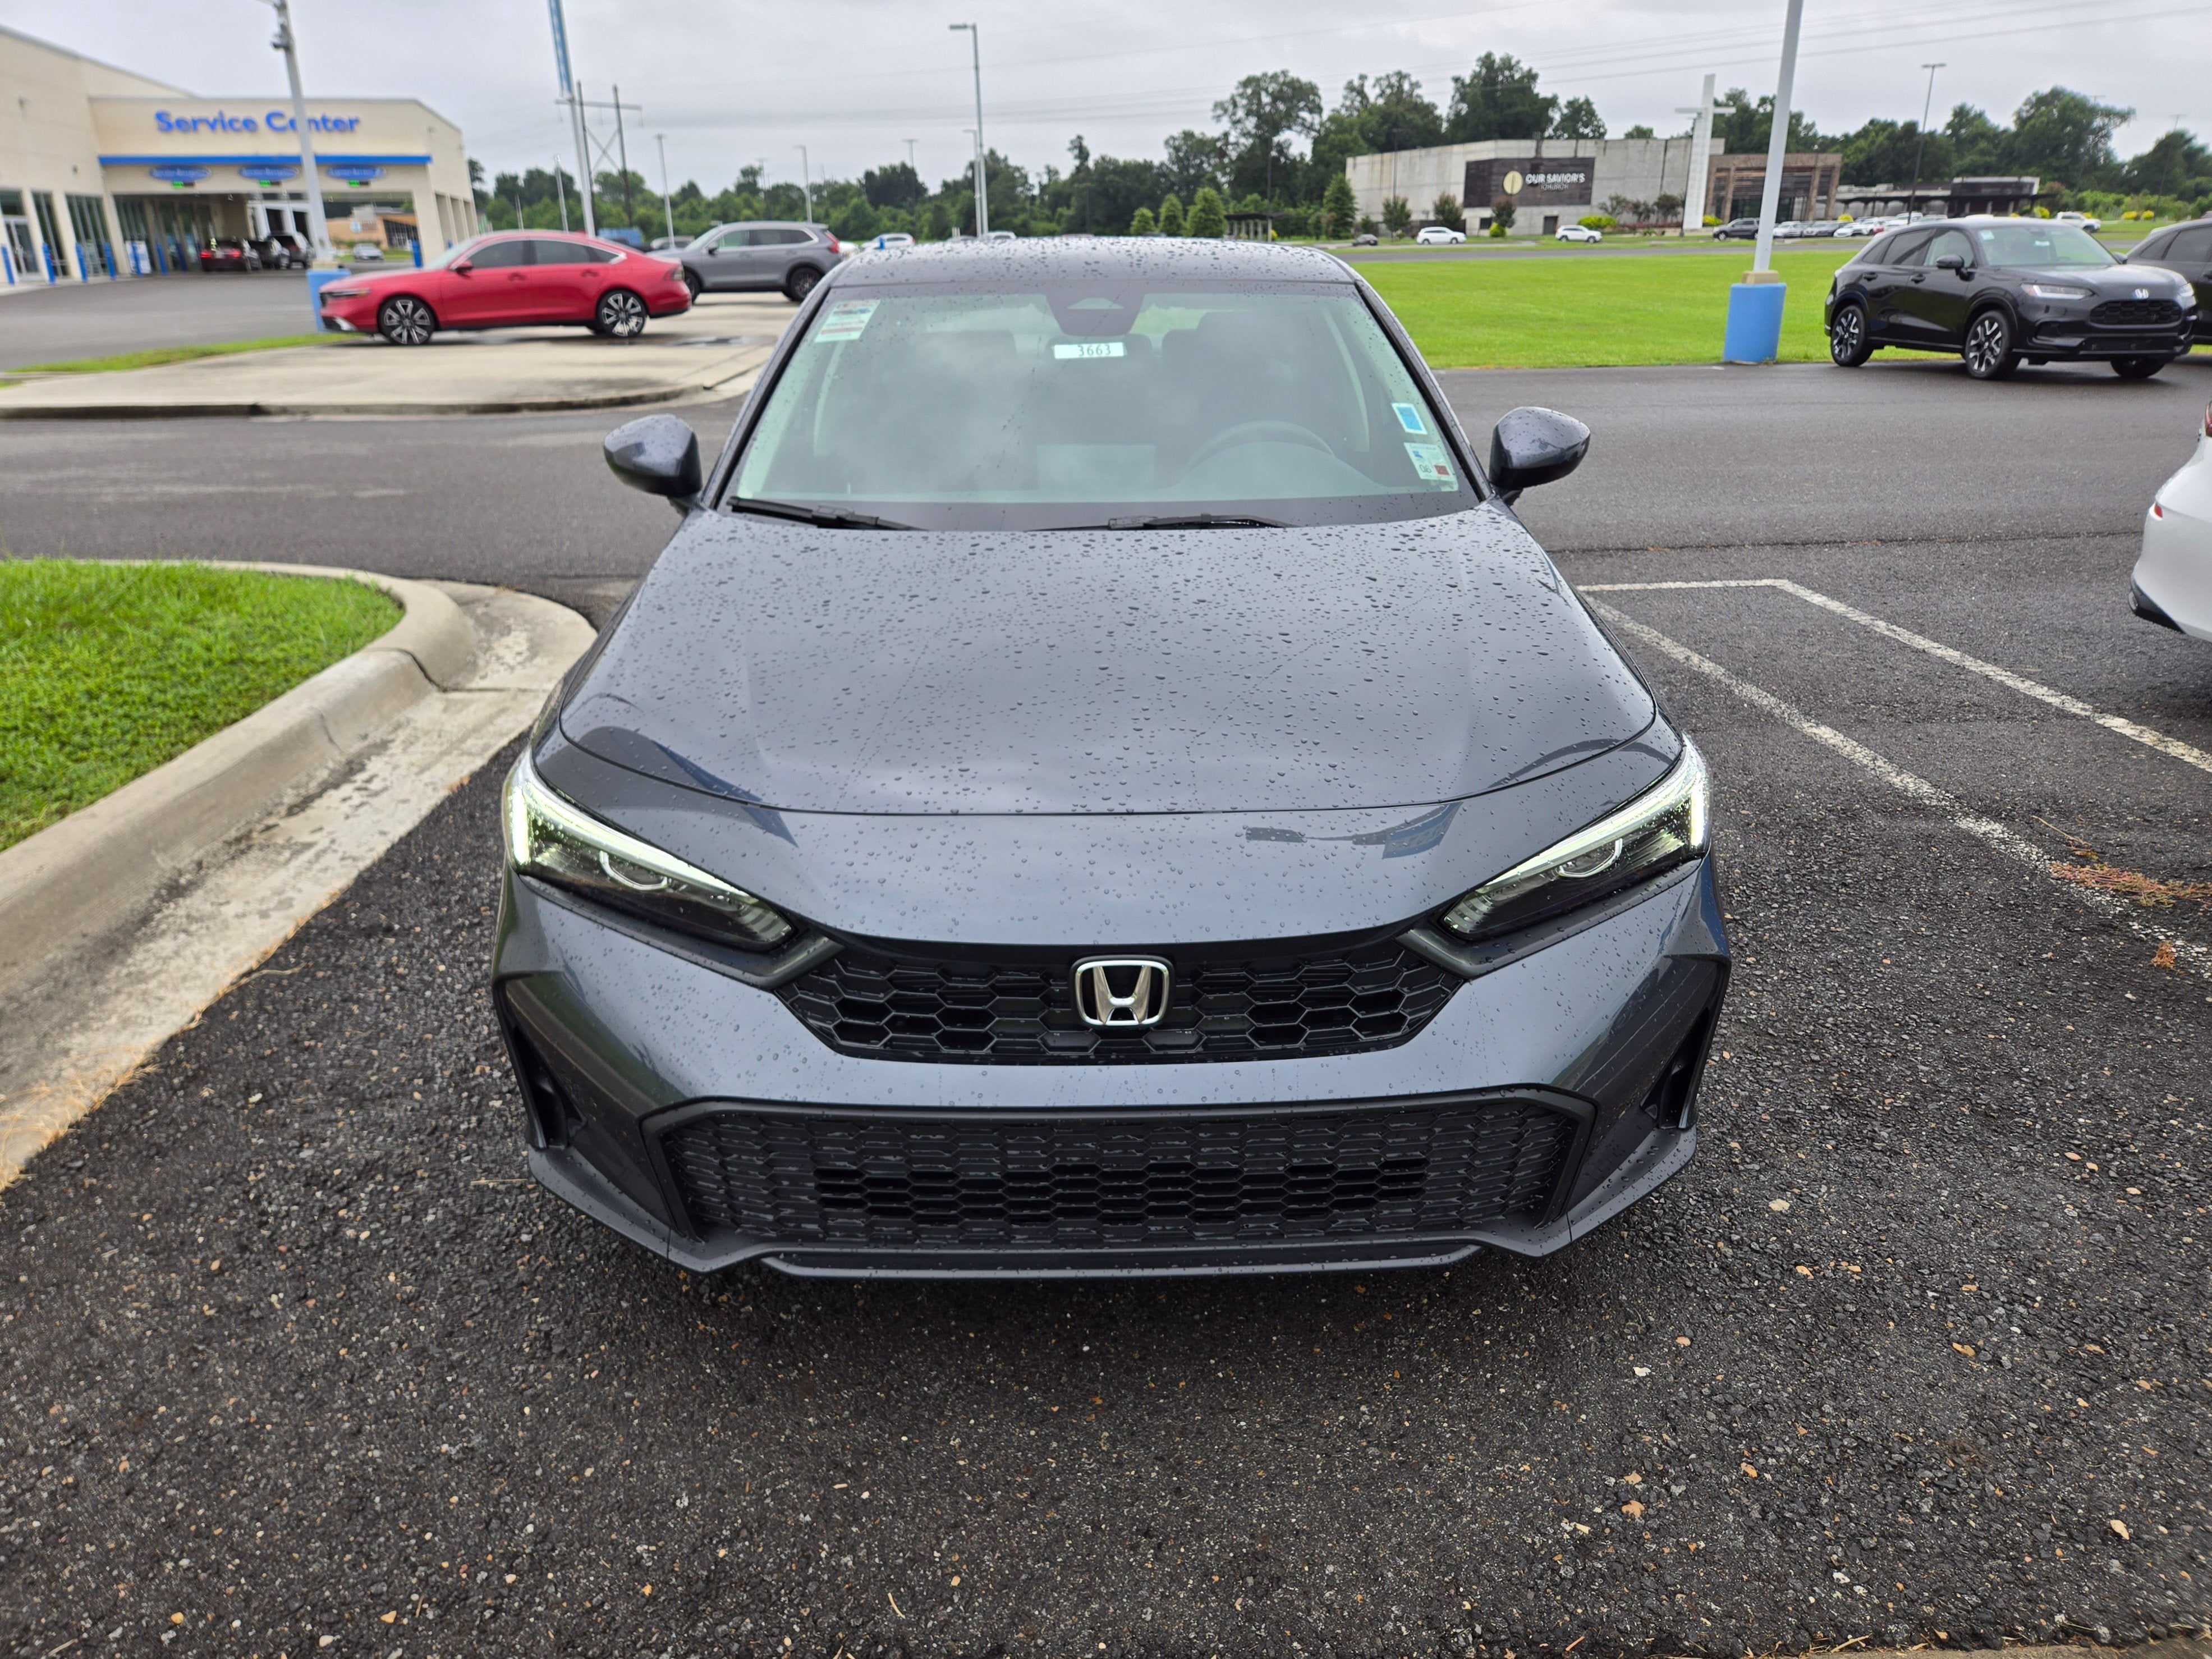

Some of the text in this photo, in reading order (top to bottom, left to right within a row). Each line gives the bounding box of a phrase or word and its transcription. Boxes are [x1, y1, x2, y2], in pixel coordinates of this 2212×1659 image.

[155, 110, 258, 132] Service
[1525, 174, 1546, 184] OUR
[1077, 344, 1111, 356] 3663
